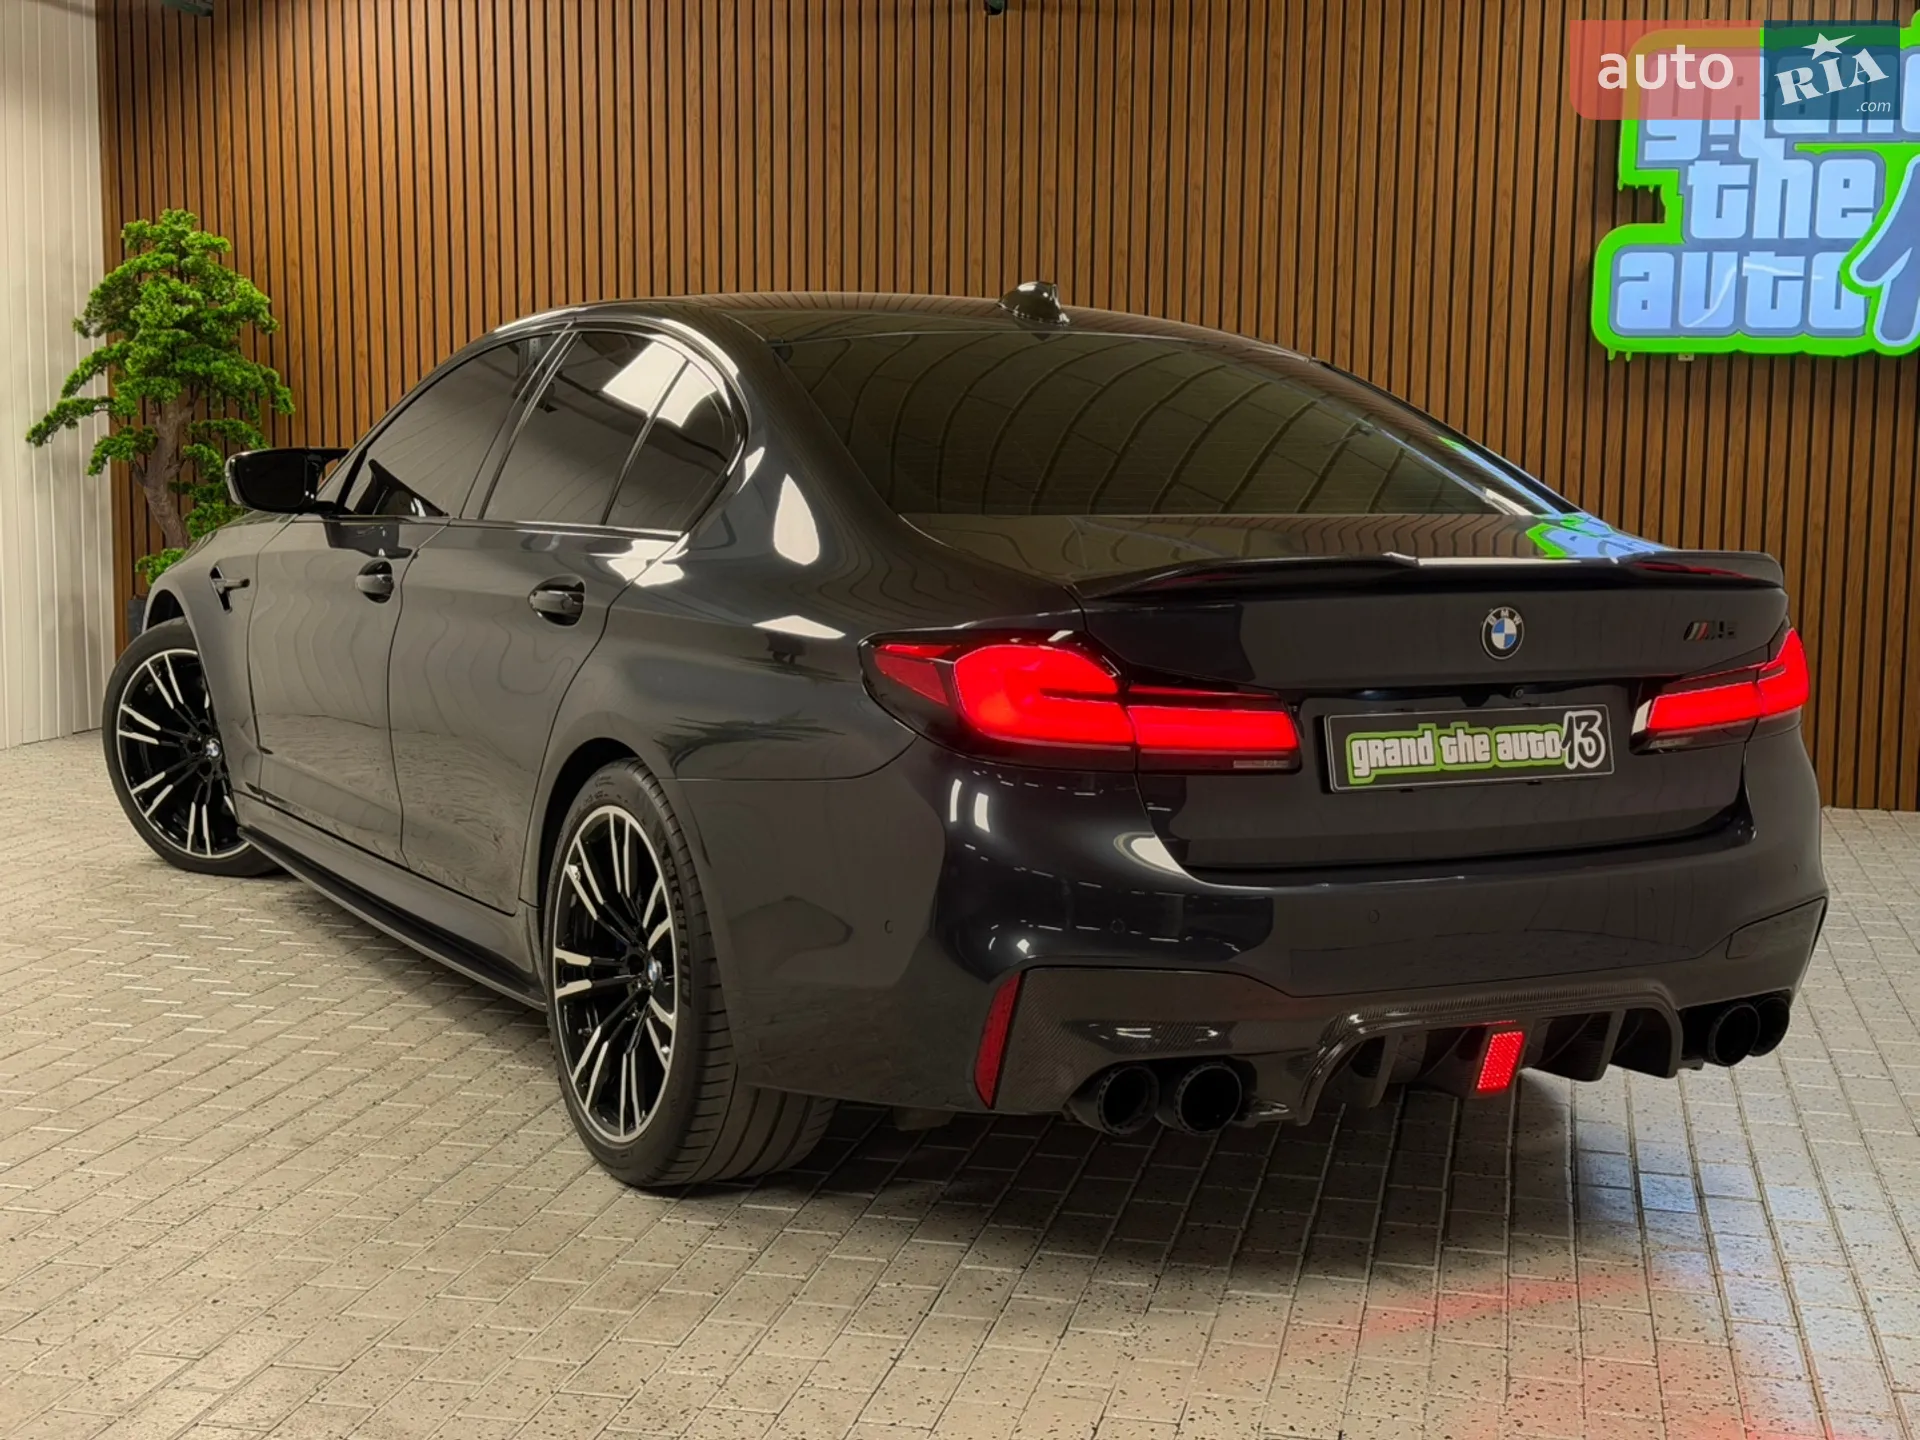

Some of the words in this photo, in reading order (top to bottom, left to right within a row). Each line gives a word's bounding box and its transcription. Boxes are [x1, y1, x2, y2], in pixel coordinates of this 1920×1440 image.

[1687, 138, 1877, 239] the
[1616, 252, 1866, 329] auto
[1439, 728, 1491, 764] the
